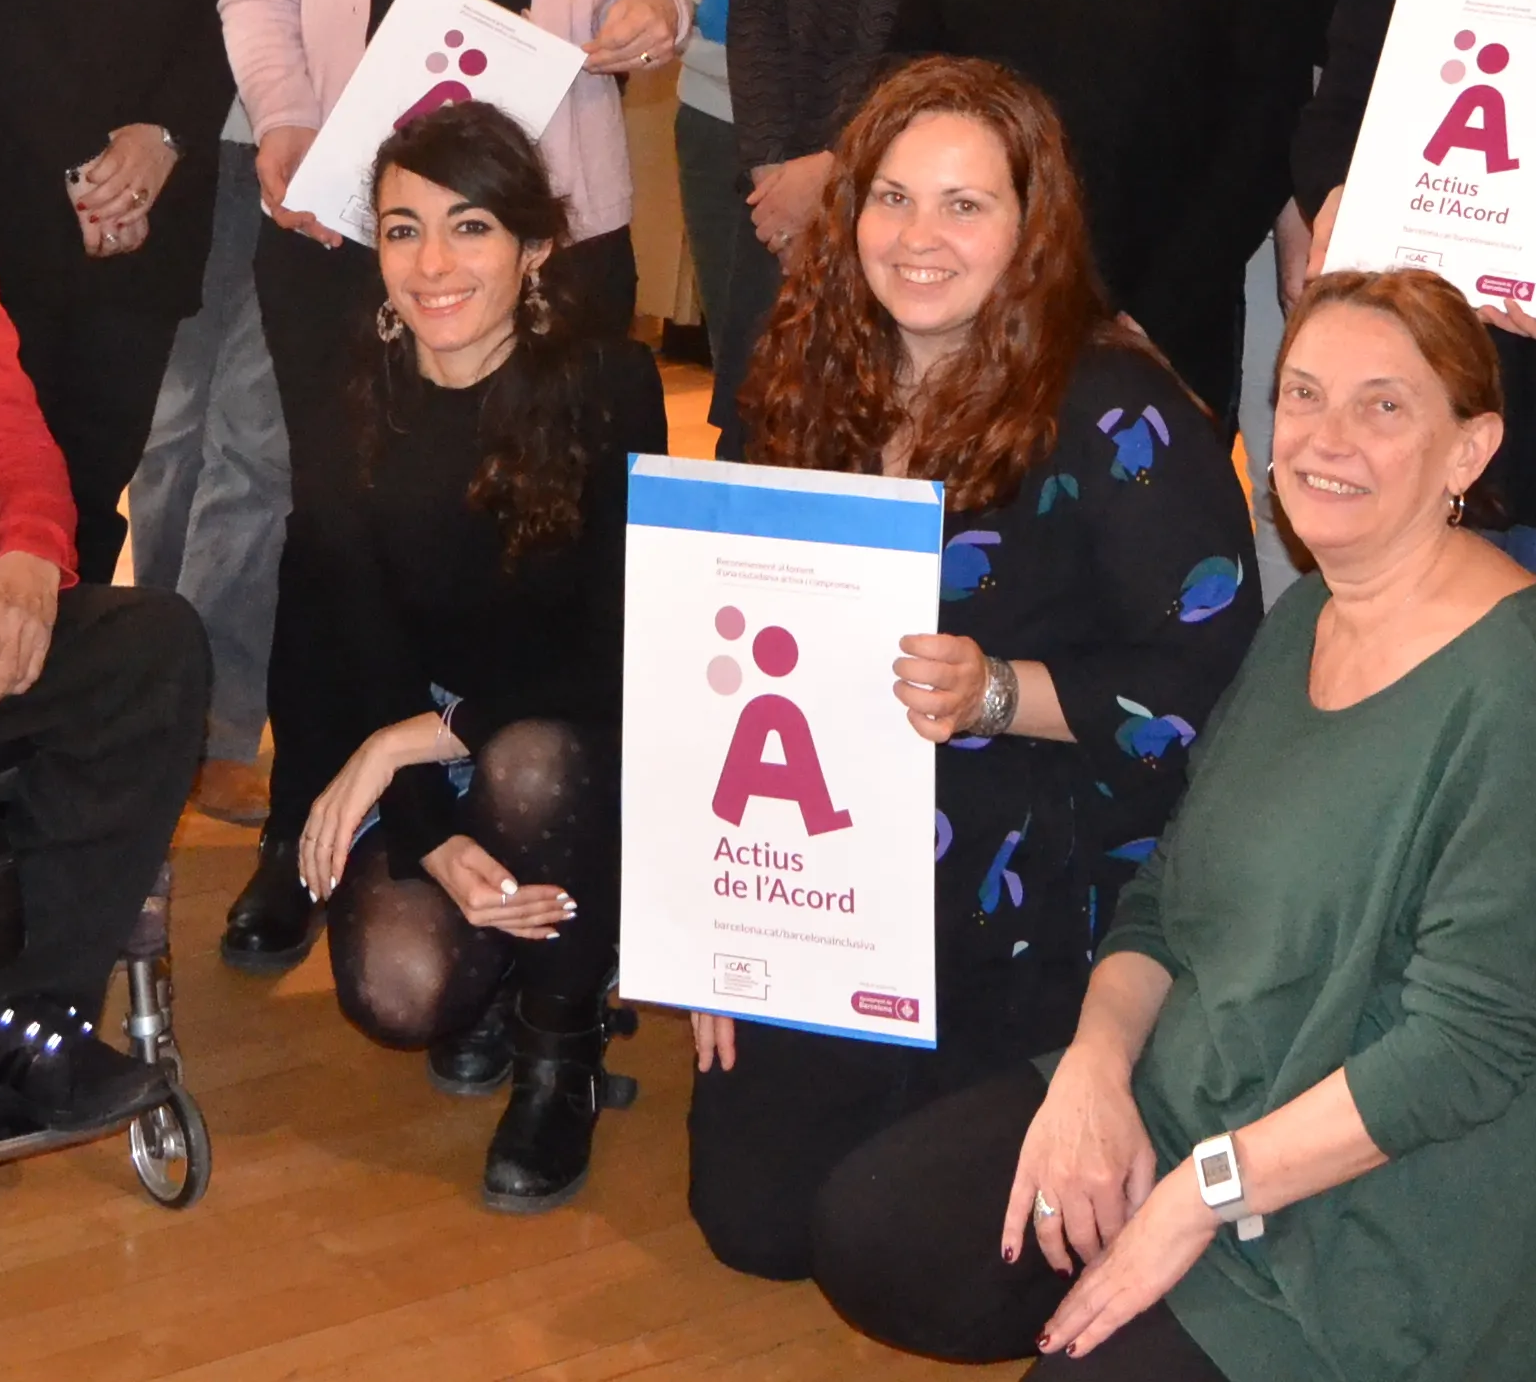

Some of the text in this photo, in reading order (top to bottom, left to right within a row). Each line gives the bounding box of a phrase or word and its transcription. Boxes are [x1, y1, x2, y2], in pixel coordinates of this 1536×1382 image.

[1415, 172, 1479, 197] Actius
[1410, 194, 1510, 224] de l'Acord
[713, 836, 804, 872] Actius
[714, 871, 855, 914] de l'Acord
[714, 919, 876, 951] barcelona.cat/barcelonainclusiva
